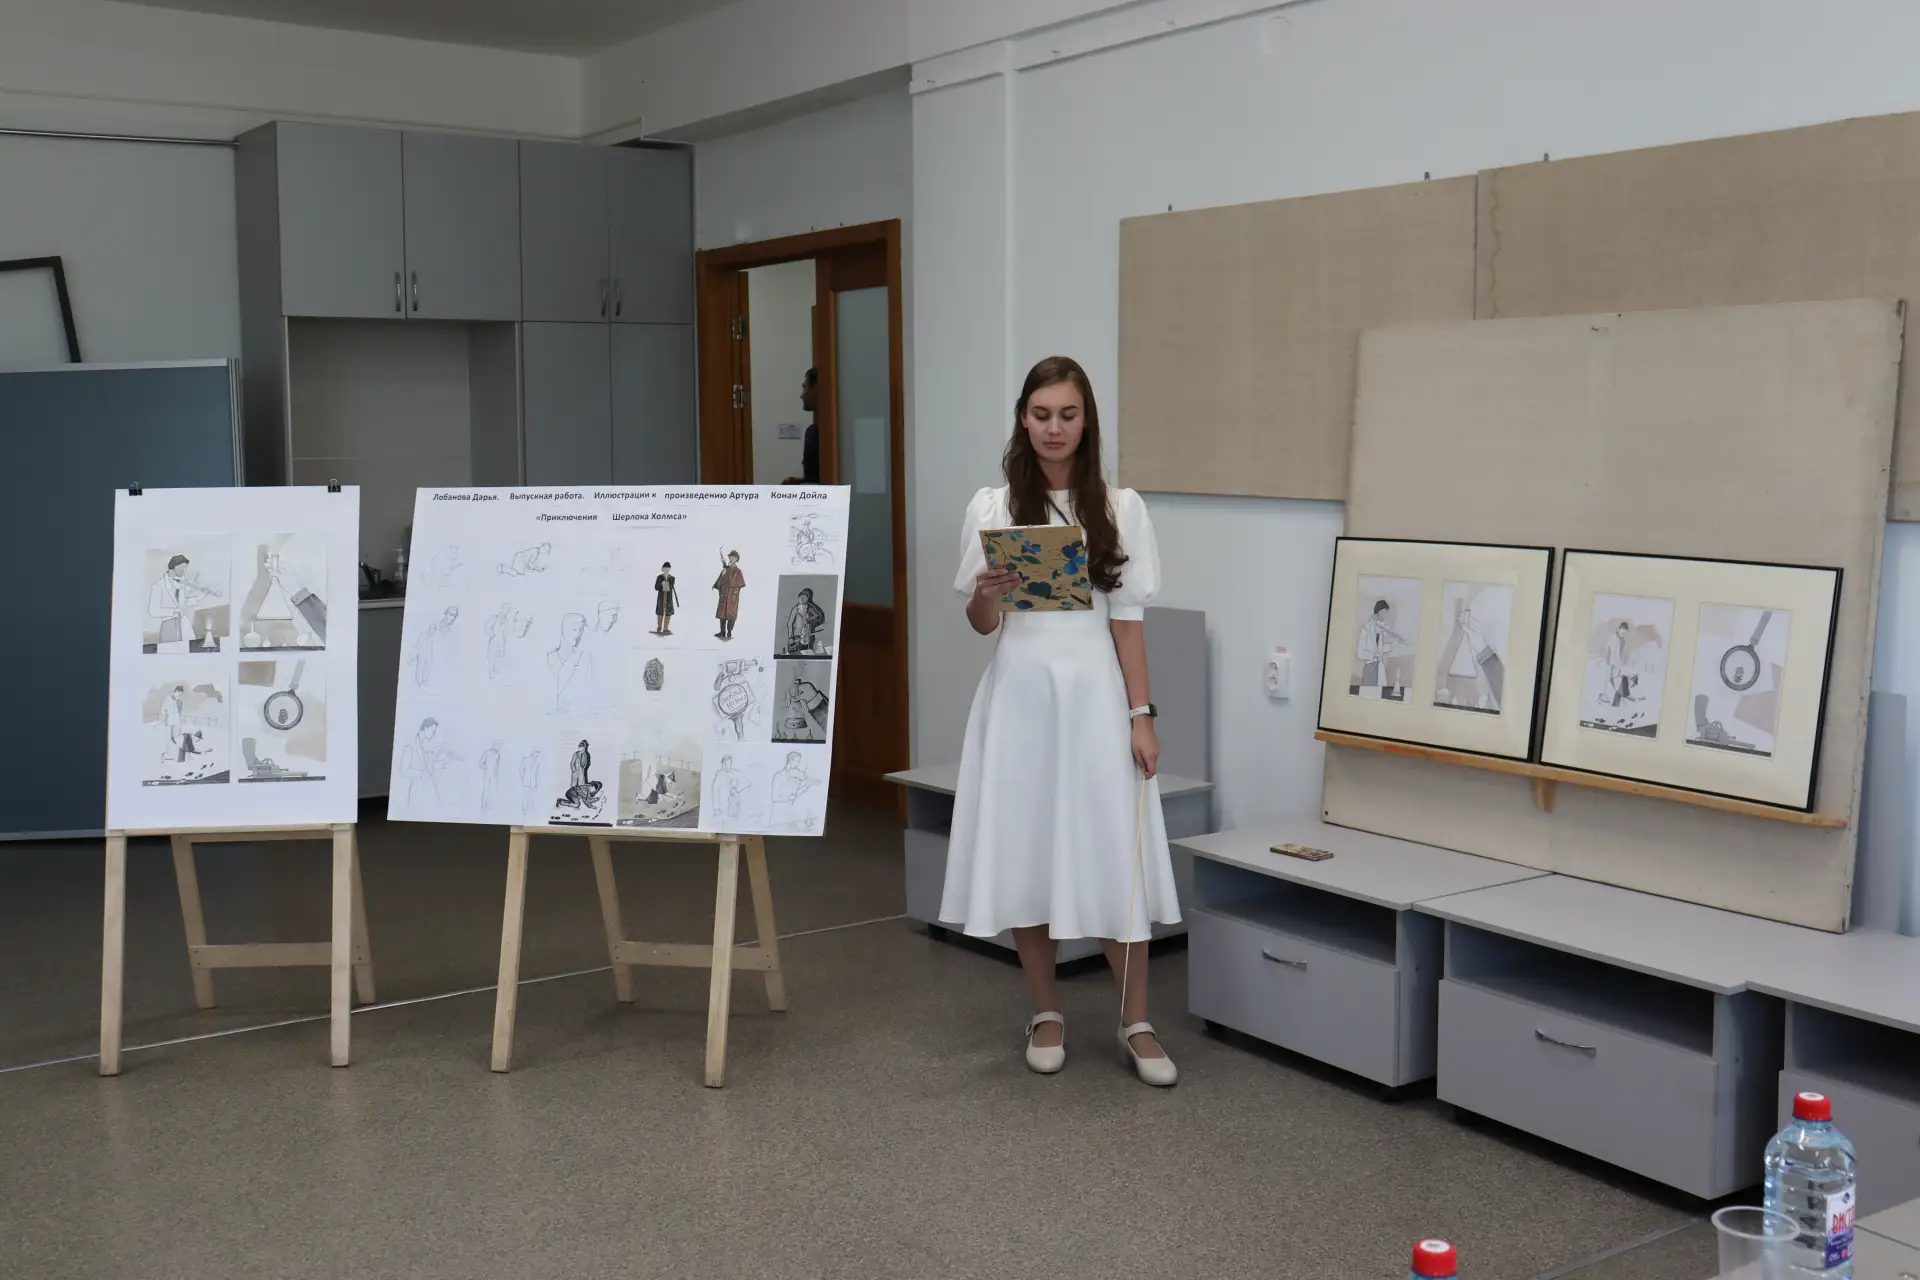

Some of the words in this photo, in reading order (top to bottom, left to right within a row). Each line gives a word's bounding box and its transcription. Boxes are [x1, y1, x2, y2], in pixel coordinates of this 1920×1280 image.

[433, 493, 471, 501] Лобанова
[472, 493, 500, 502] Дарья.
[510, 492, 553, 502] Выпускная
[554, 491, 585, 501] работа.
[594, 491, 650, 501] Иллюстрации
[664, 492, 728, 500] произведению
[729, 491, 759, 501] Артура
[771, 491, 797, 499] Конан
[799, 490, 828, 500] Дойла
[536, 513, 598, 522] «Приключения
[612, 513, 649, 522] Шерлока
[651, 512, 687, 521] Холмса»
